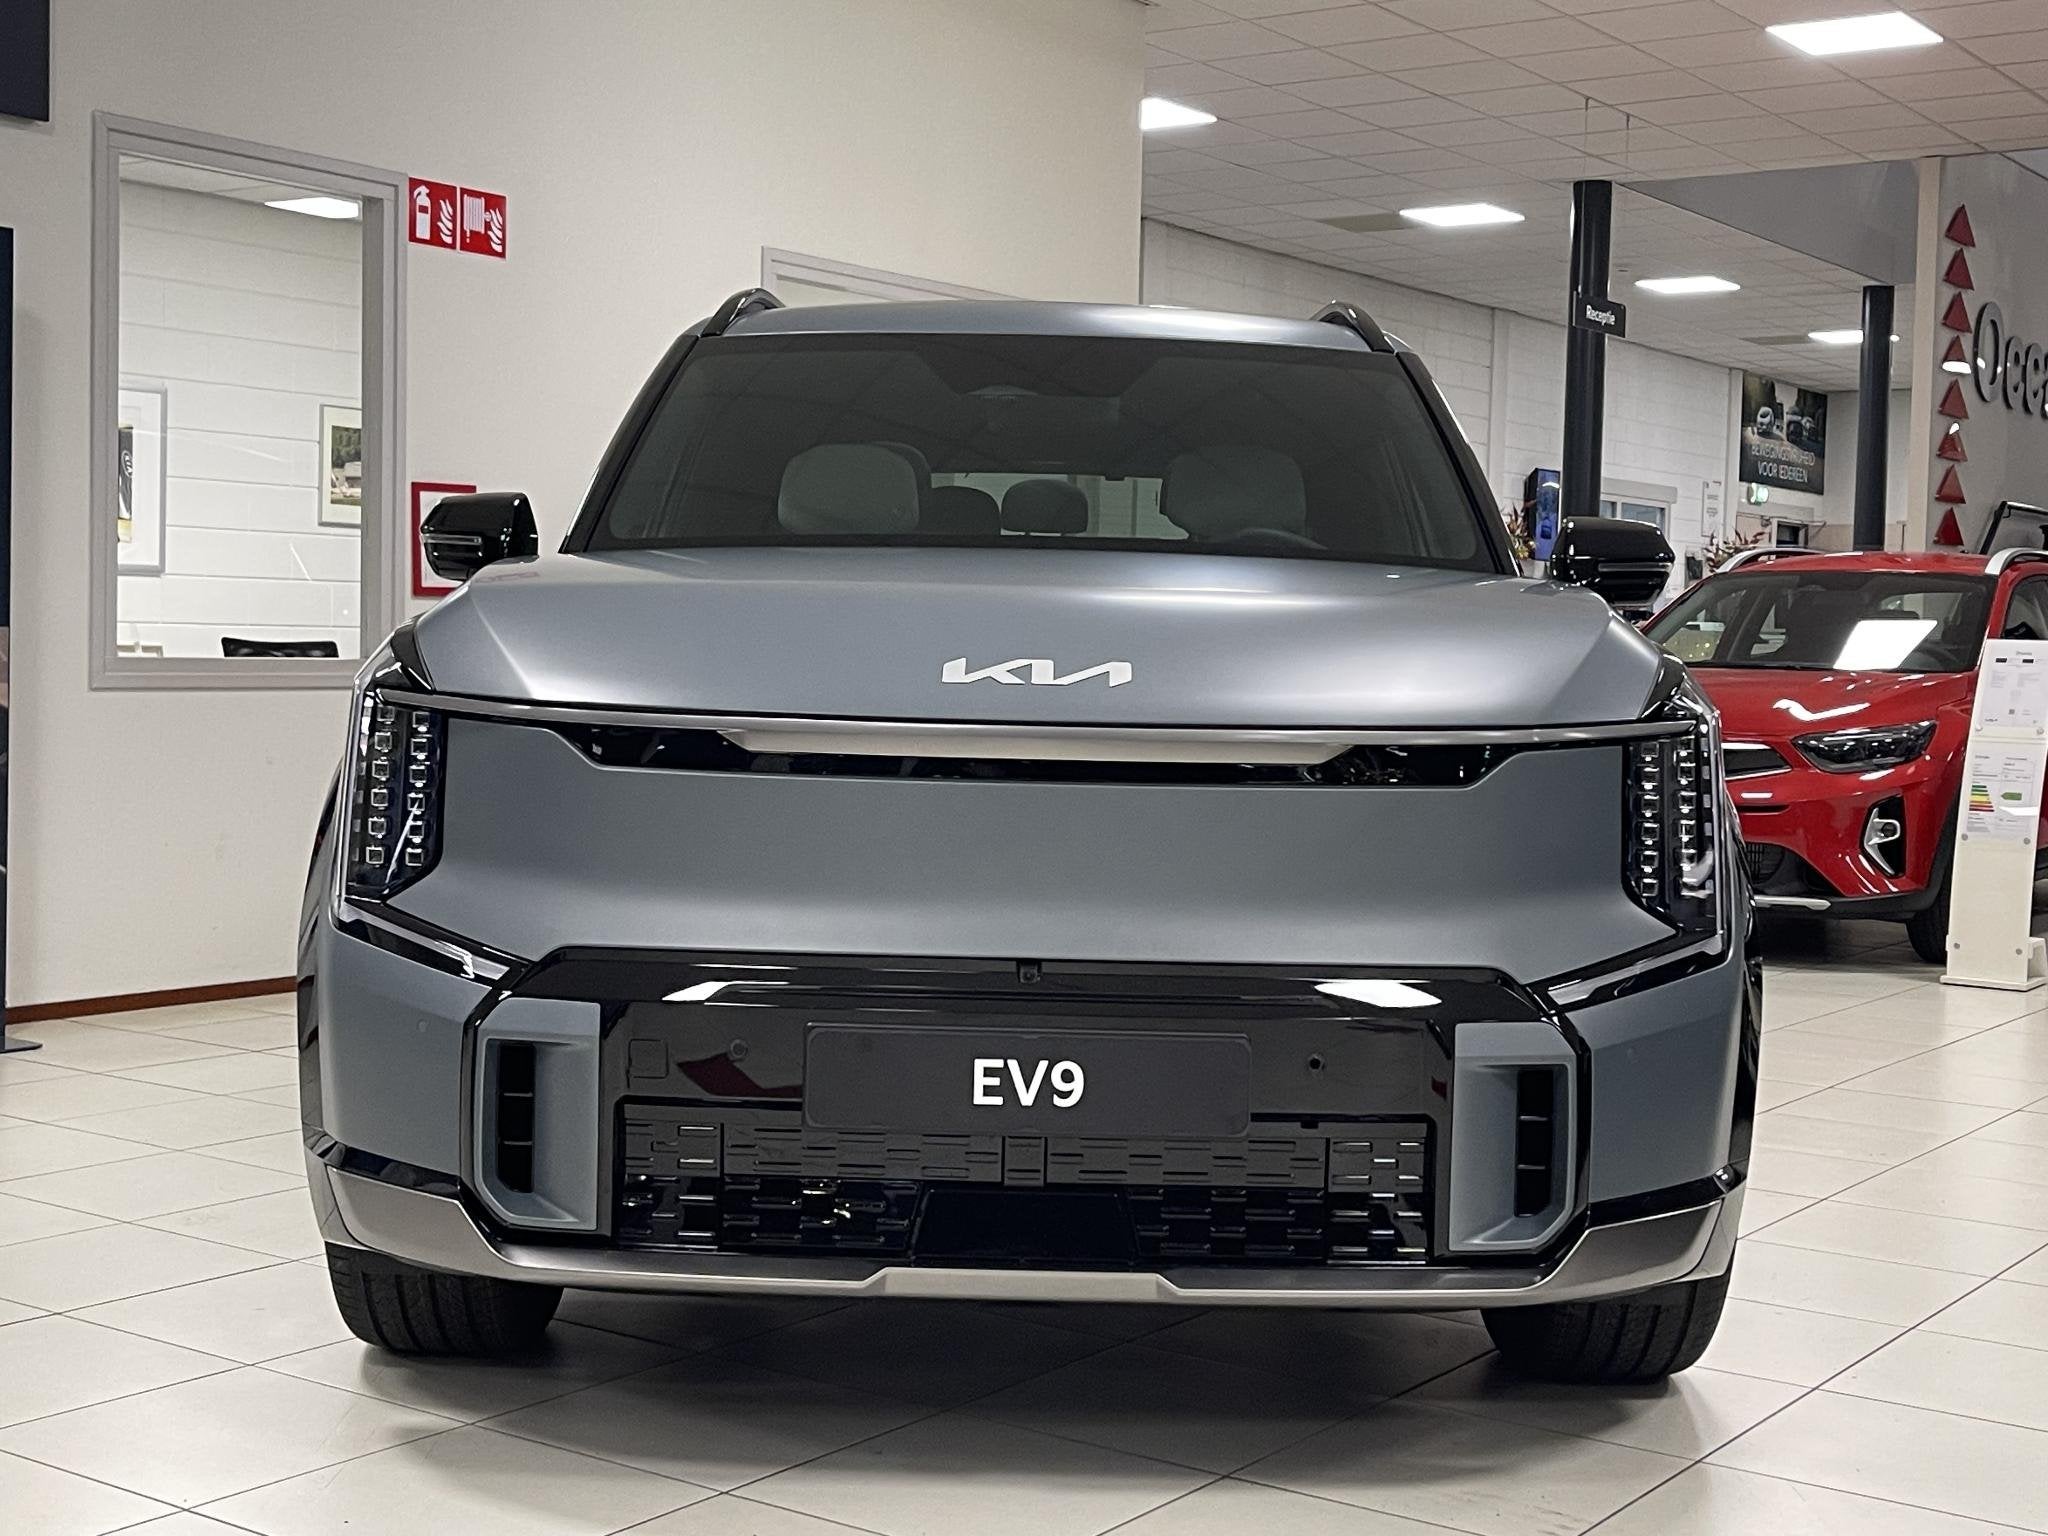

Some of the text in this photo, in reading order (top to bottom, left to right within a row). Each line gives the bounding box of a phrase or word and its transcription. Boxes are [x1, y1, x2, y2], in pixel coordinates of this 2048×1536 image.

[1585, 304, 1616, 326] Receptie
[1757, 460, 1778, 478] VOOR
[941, 657, 1133, 688] KIA
[972, 1058, 1085, 1108] EV9
